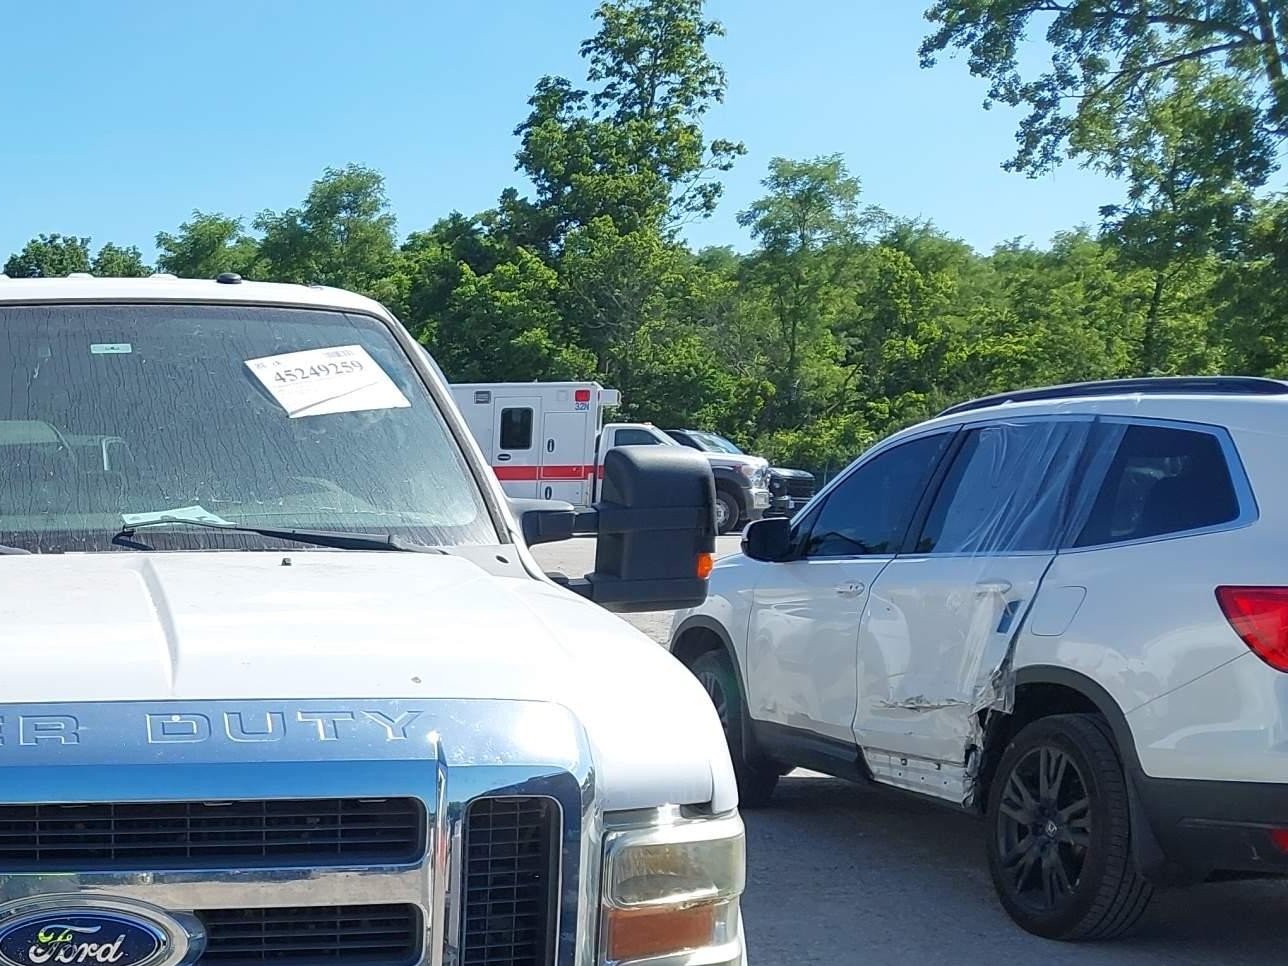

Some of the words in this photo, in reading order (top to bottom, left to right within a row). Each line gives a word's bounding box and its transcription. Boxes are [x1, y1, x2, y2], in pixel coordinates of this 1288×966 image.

[274, 360, 364, 383] 45249259
[145, 710, 425, 744] DUTY
[28, 924, 127, 964] Ford
